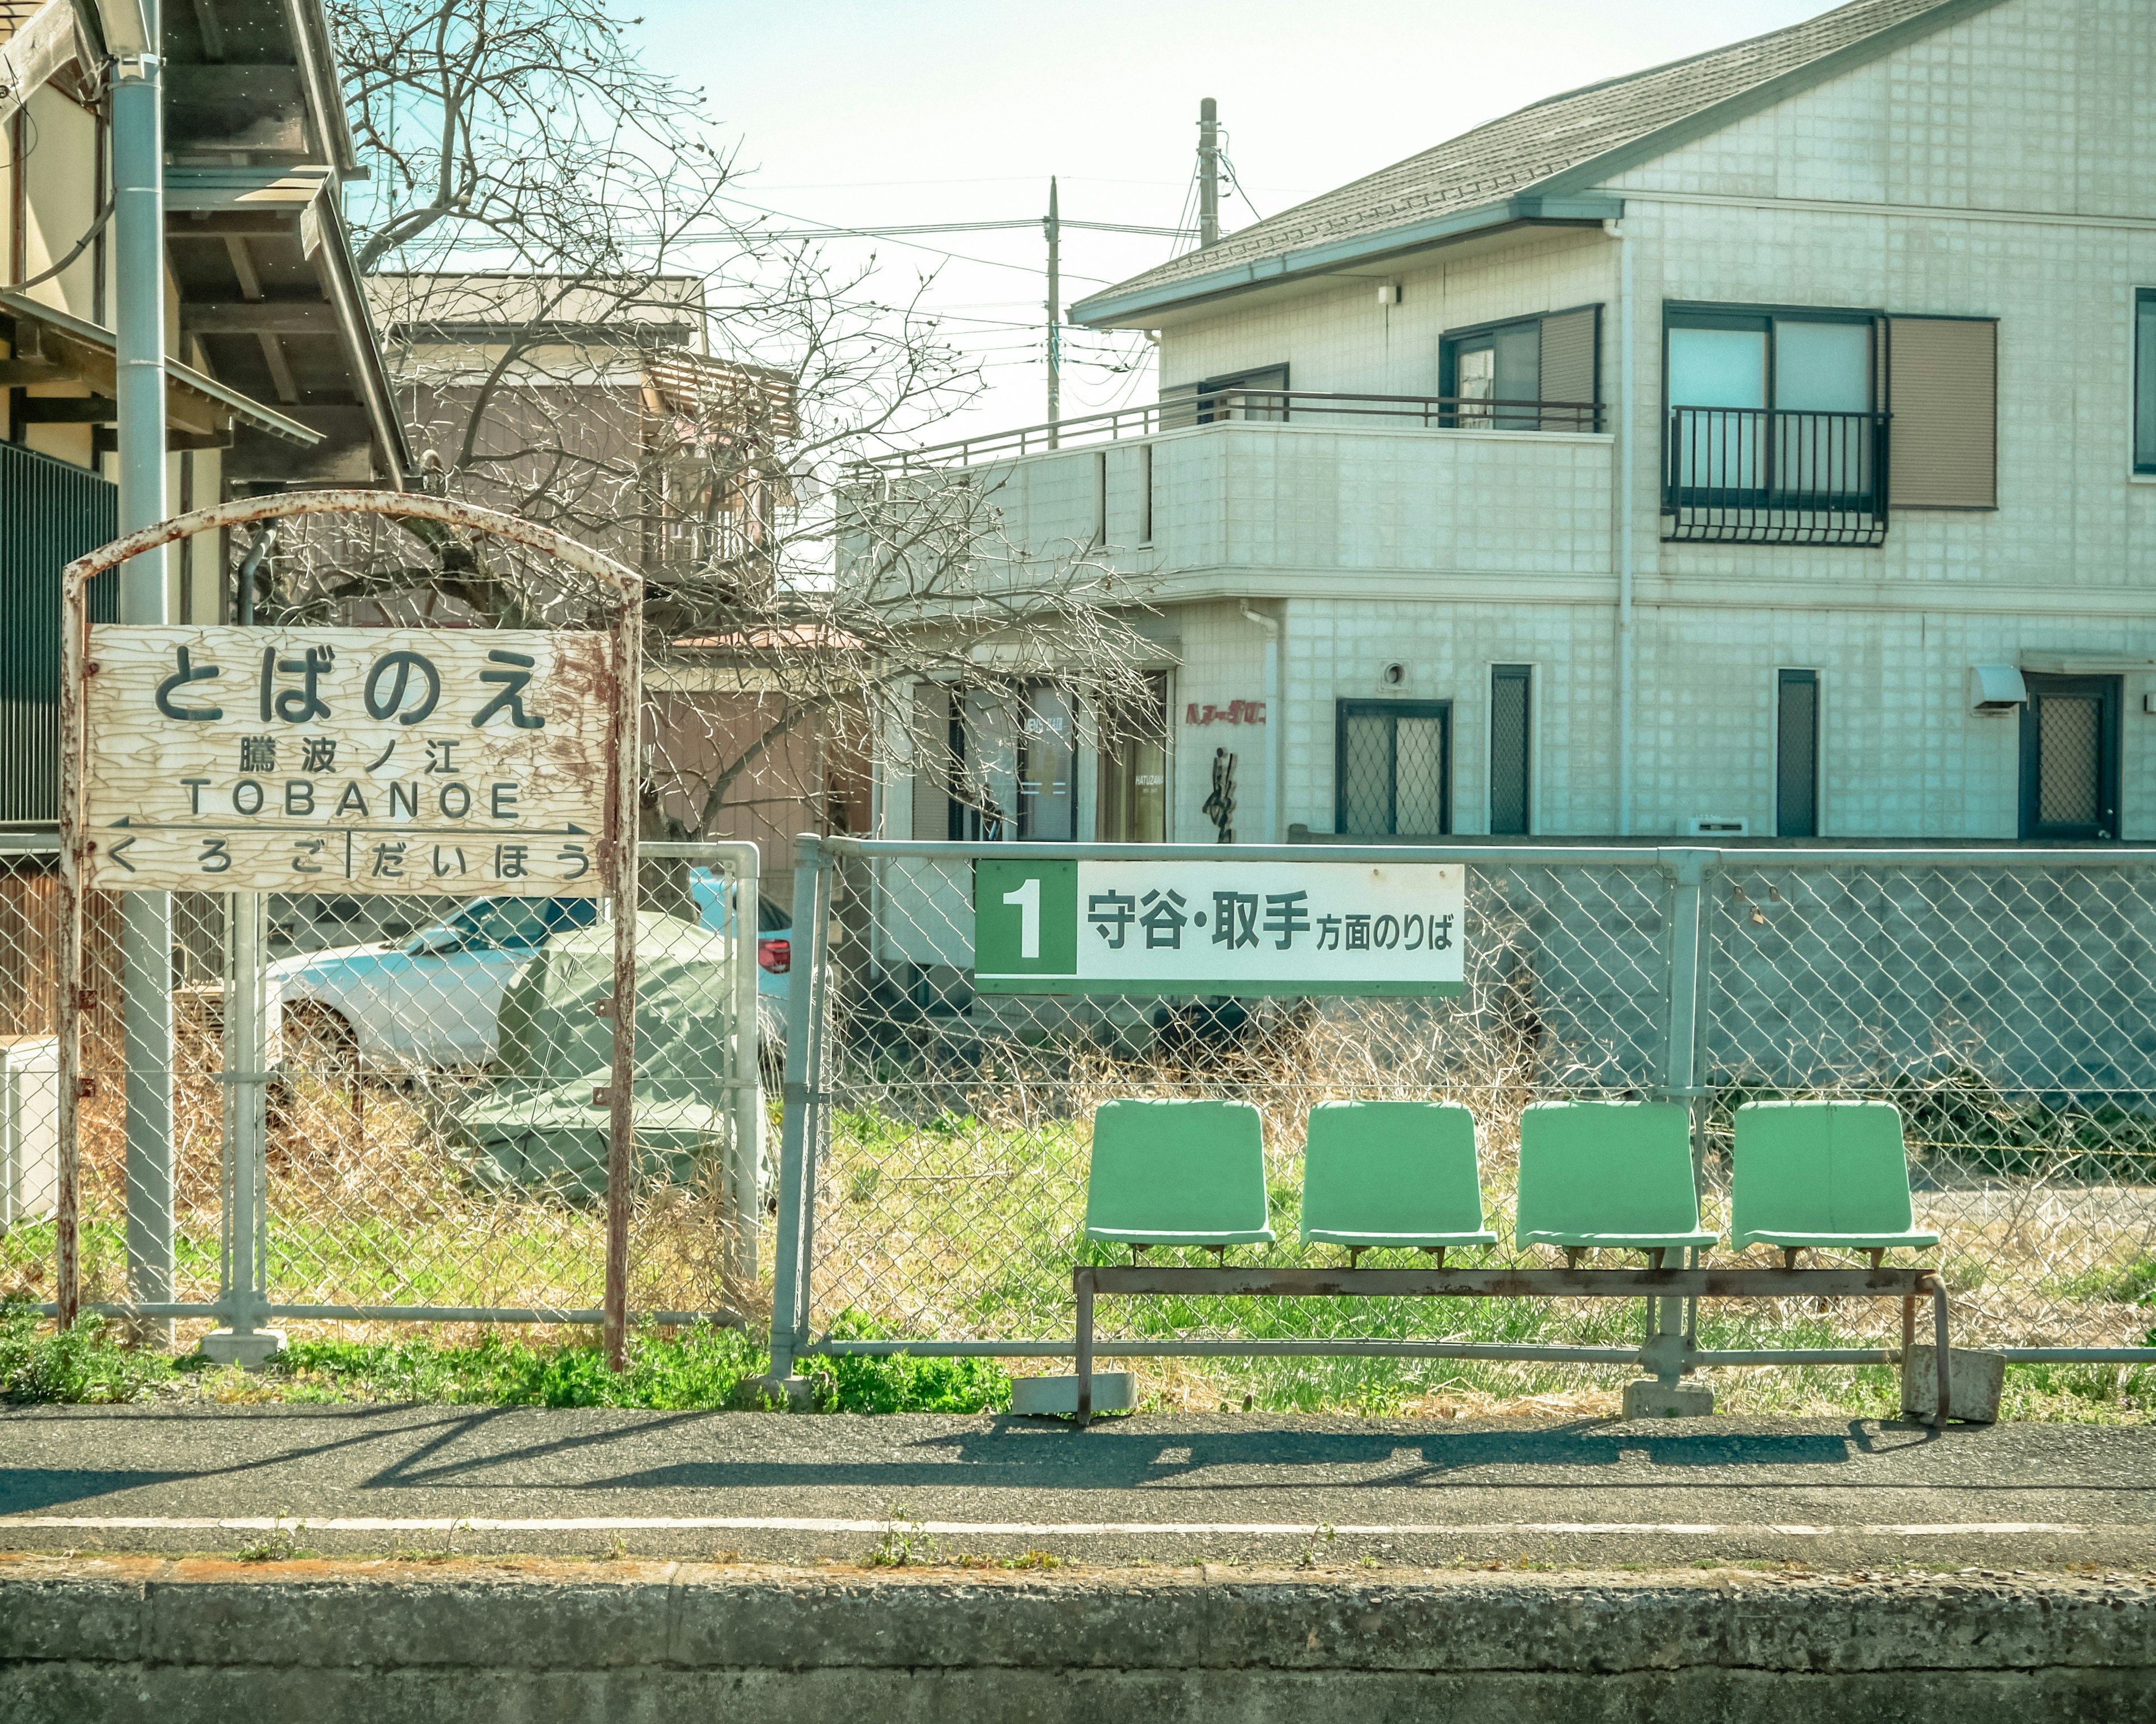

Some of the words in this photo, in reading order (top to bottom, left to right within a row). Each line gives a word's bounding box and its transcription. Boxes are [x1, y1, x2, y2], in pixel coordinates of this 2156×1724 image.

[155, 645, 546, 729] とばのえ
[239, 736, 460, 774] 騰波ノ江
[180, 779, 519, 819] TOBANOE
[107, 837, 325, 873] くろご
[371, 842, 590, 880] だいほう
[1003, 879, 1040, 958] 1
